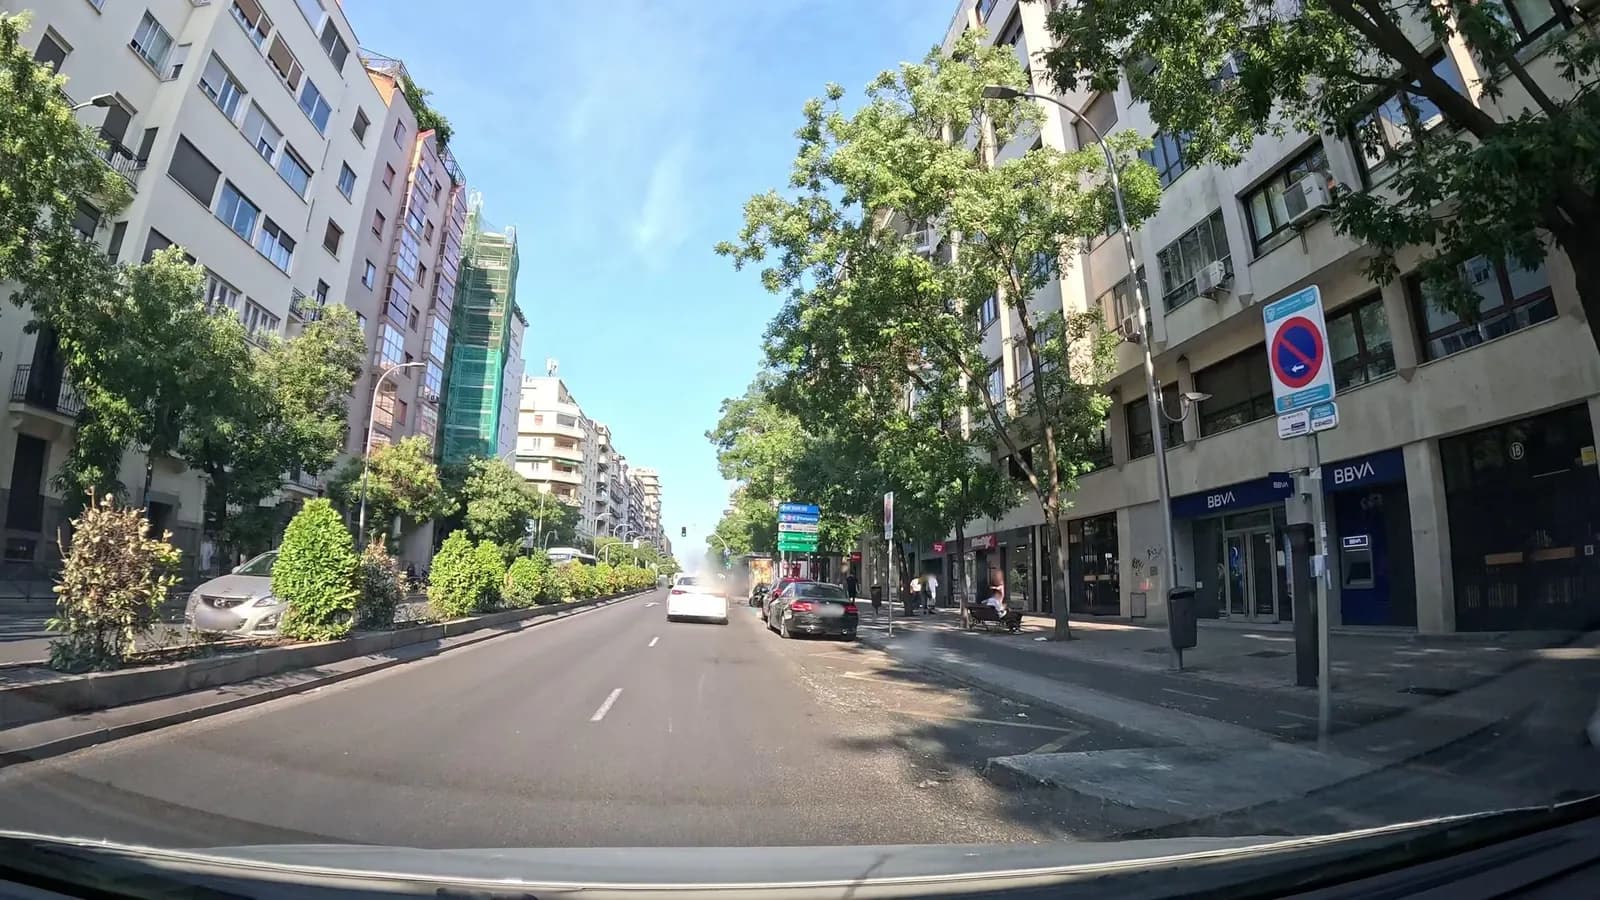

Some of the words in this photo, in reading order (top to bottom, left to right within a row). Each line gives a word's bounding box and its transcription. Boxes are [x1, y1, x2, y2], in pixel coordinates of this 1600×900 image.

[1334, 461, 1375, 485] BBVA
[1273, 481, 1289, 489] BBVA
[1207, 491, 1236, 508] BBVA
